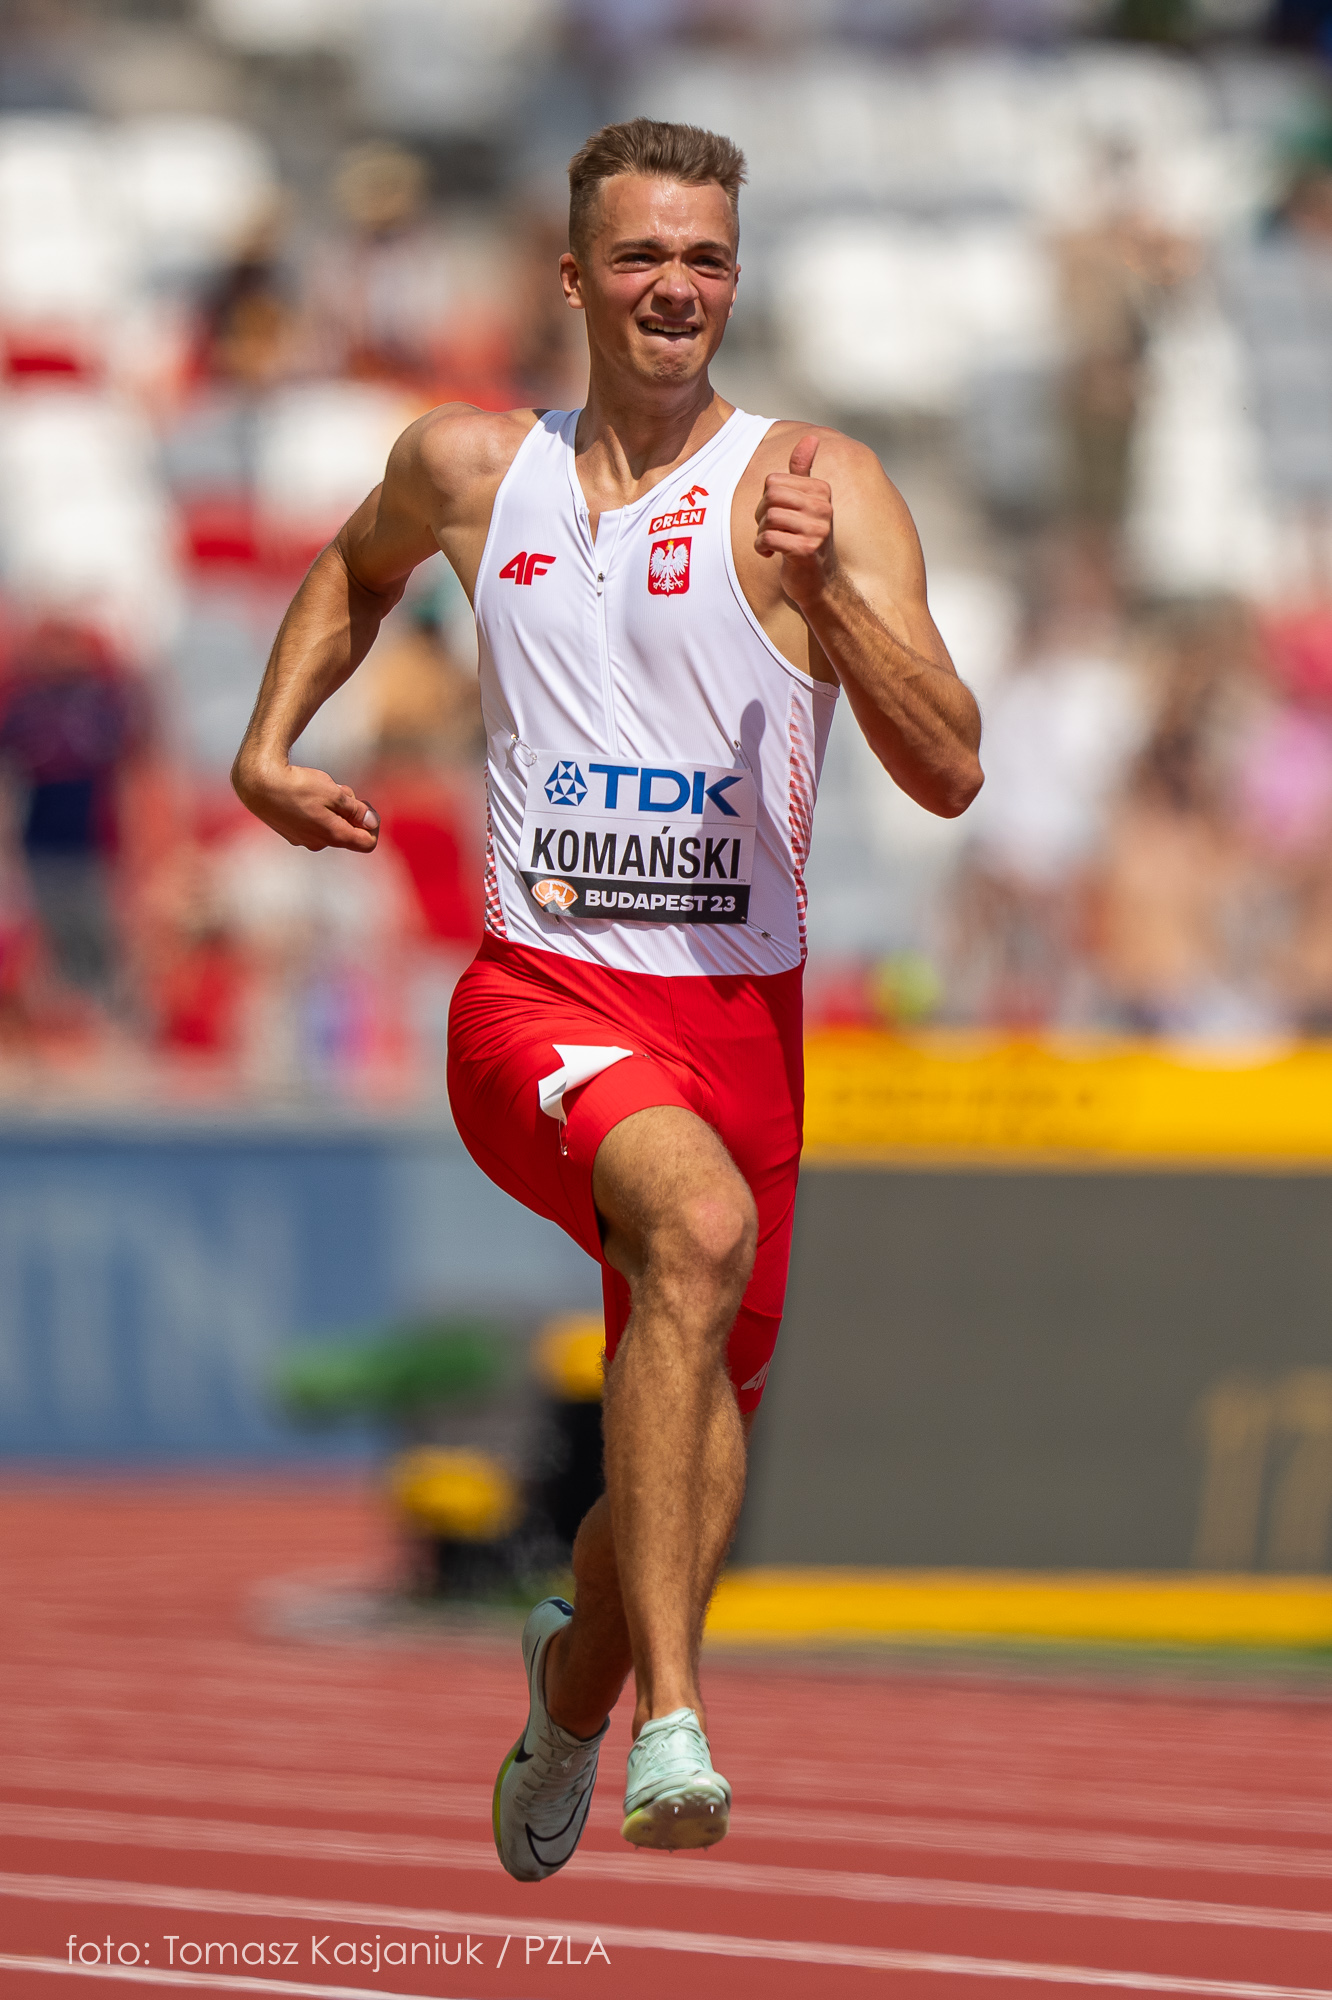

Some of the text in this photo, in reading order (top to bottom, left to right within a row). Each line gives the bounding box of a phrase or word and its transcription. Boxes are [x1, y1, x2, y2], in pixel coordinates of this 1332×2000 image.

[651, 509, 703, 532] ORLEN
[498, 551, 557, 586] 4F
[588, 762, 744, 818] TDK
[530, 825, 742, 880] KOMAŃSKI
[584, 889, 736, 912] BUDAPEST 23
